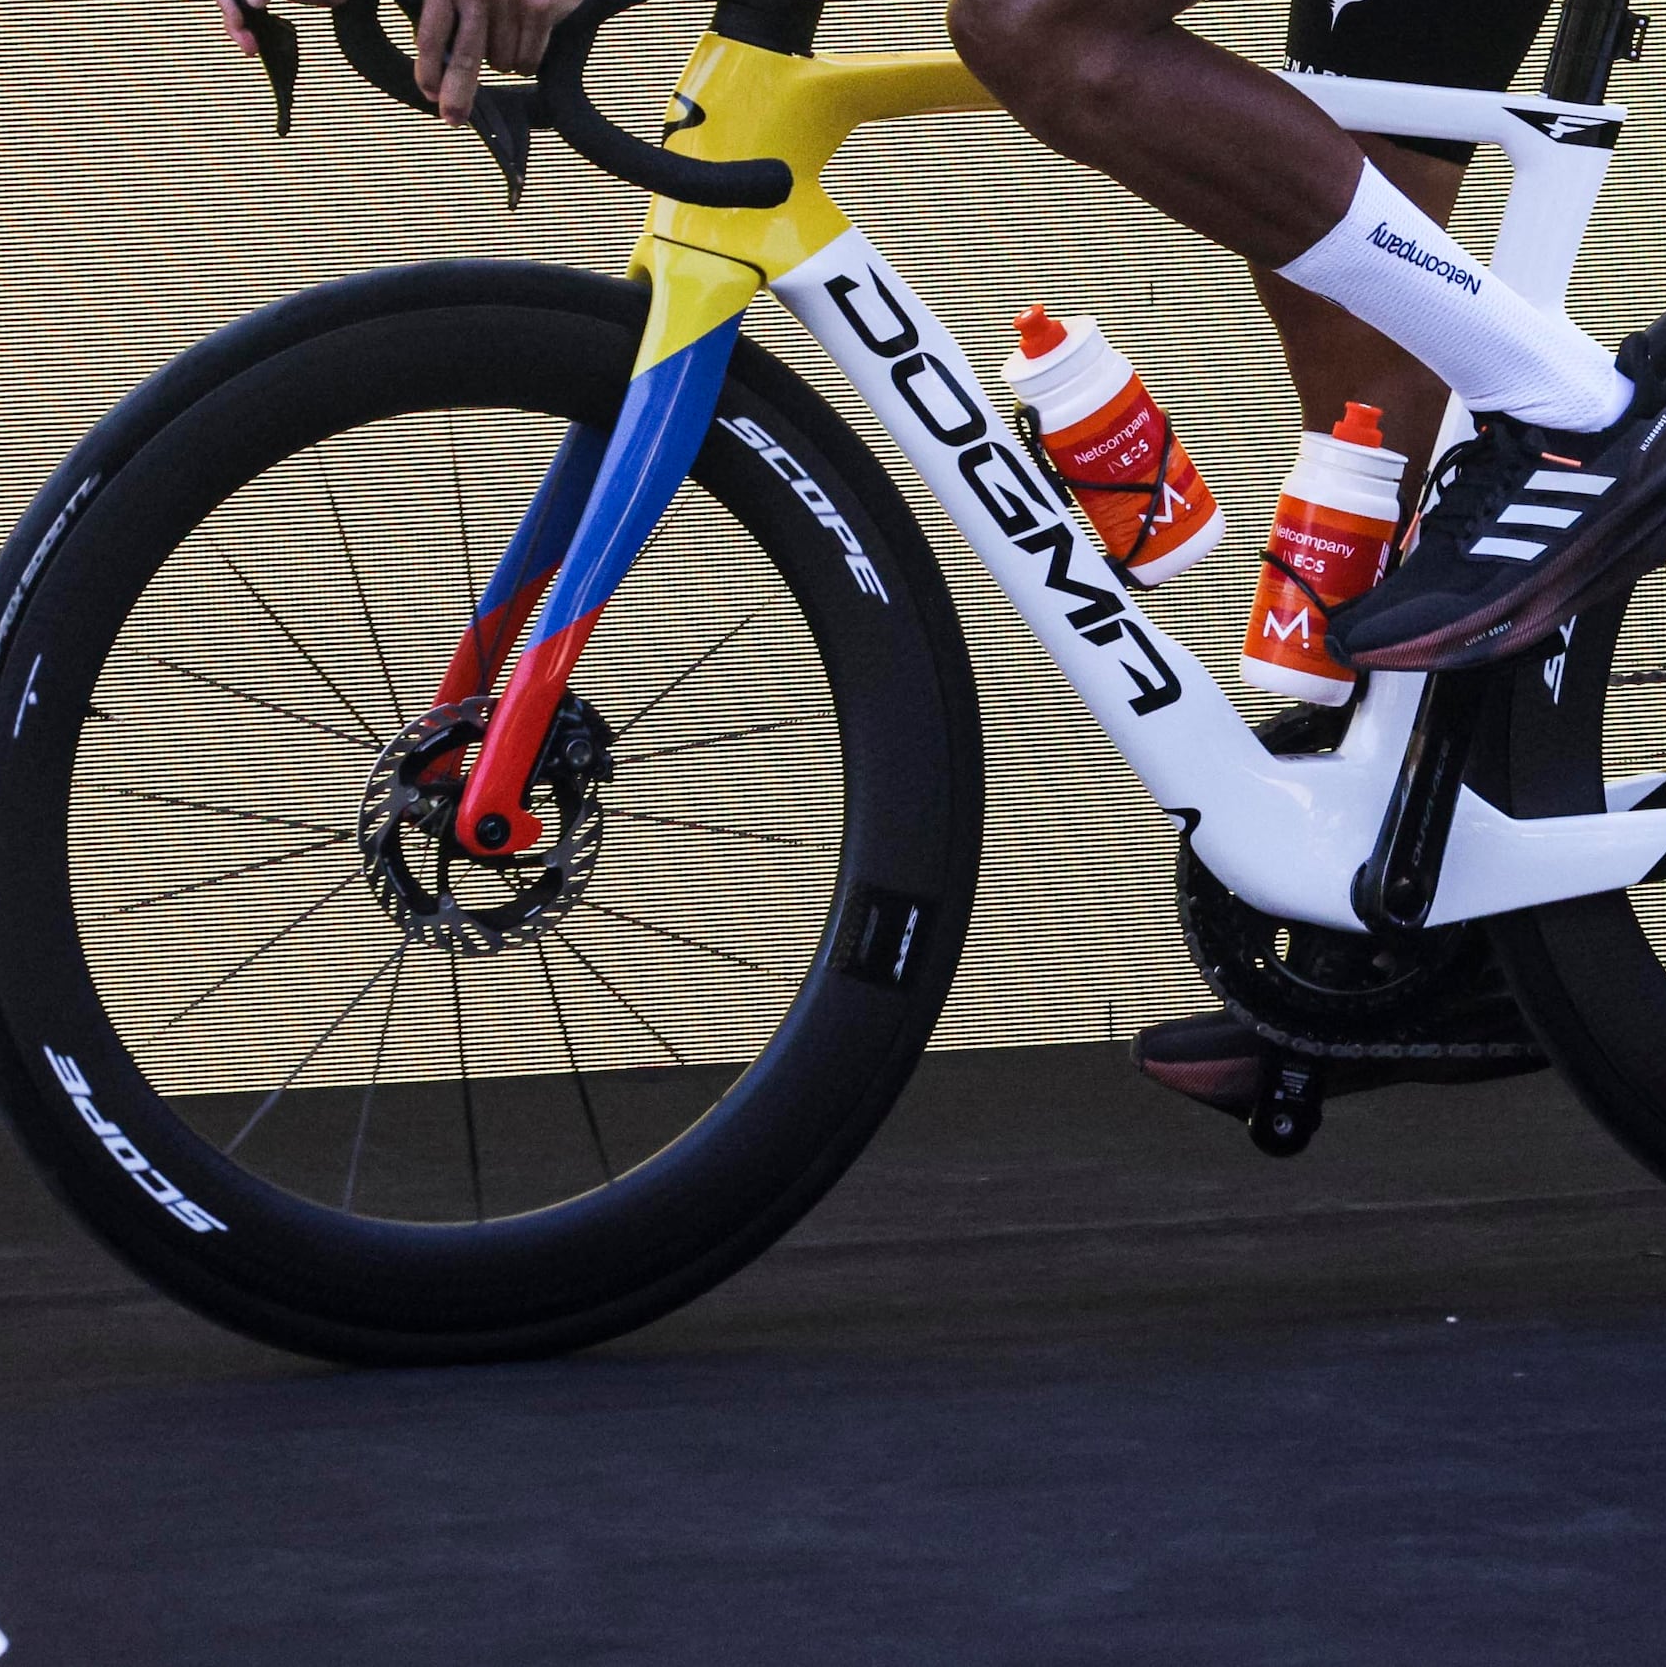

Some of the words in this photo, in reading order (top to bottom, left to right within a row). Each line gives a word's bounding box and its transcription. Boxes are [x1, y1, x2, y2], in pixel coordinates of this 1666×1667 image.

[1365, 221, 1482, 296] Netcompany
[823, 263, 1183, 718] DOGMA
[1073, 406, 1151, 467] Netcompany
[716, 416, 890, 605] SCOPE
[1281, 549, 1326, 574] INEOS
[42, 1044, 230, 1233] SCOPE
